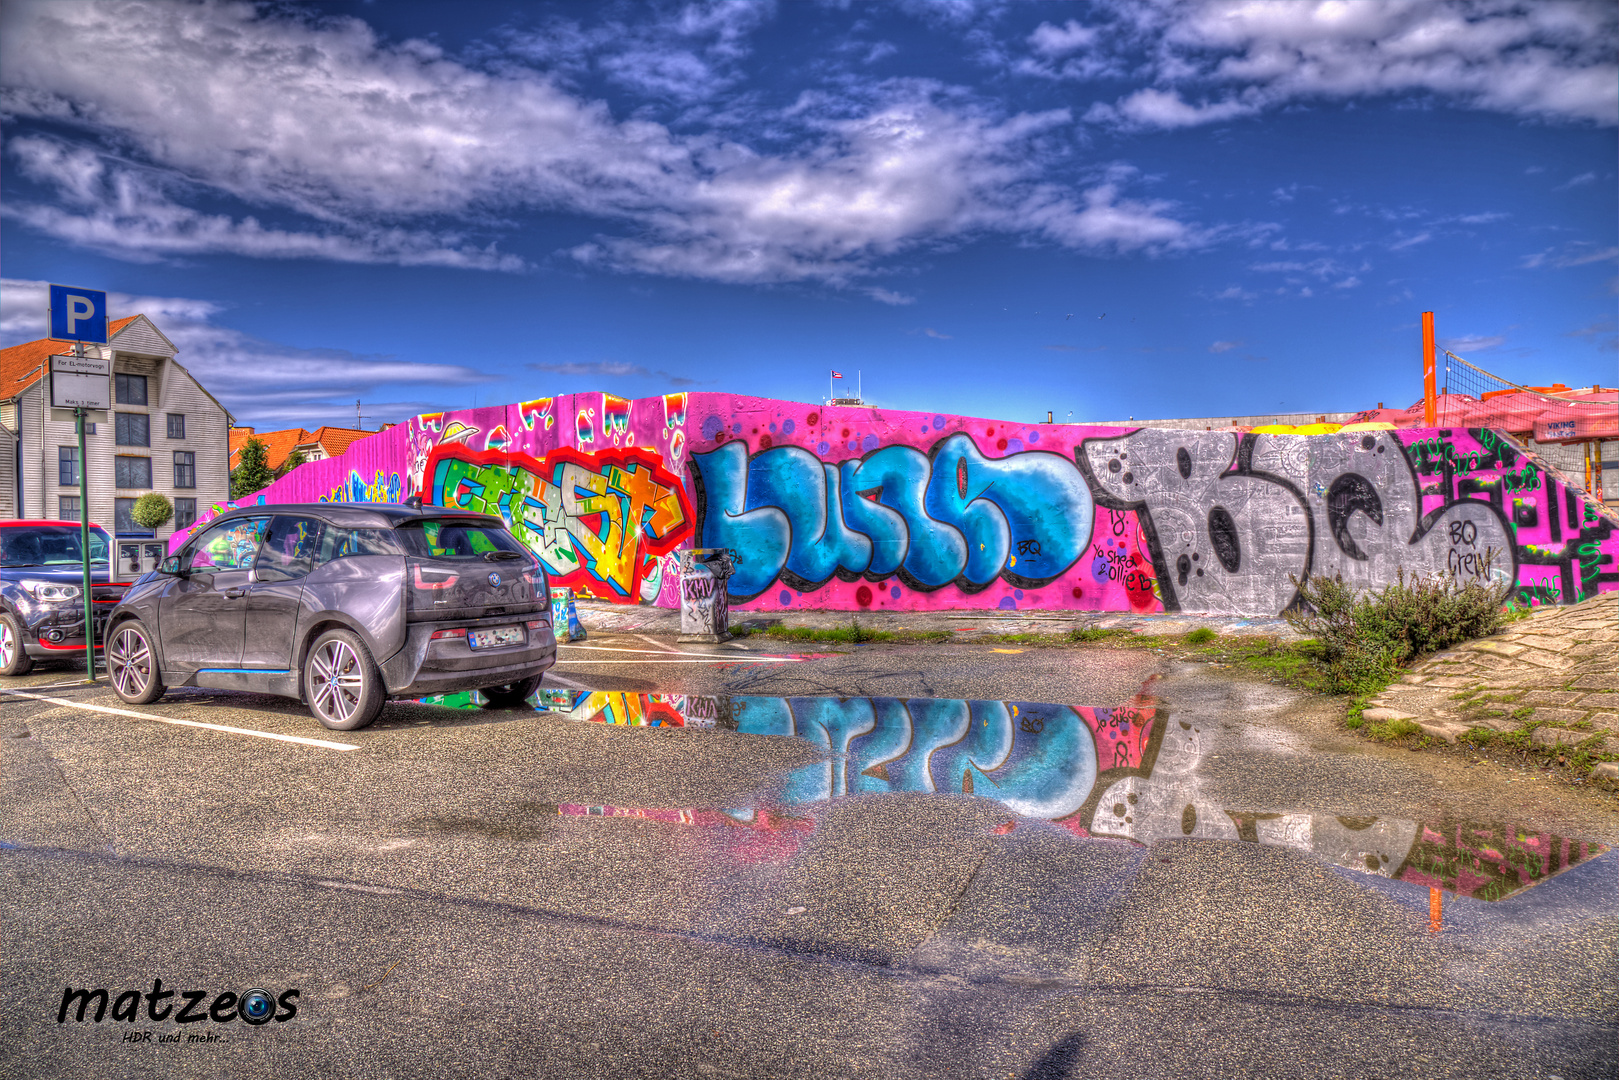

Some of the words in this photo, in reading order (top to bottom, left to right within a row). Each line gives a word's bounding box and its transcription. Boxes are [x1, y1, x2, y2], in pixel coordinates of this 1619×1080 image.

[66, 294, 95, 334] P
[1547, 420, 1576, 430] VIKING
[1449, 520, 1477, 550] BQ
[1016, 539, 1042, 557] BQ
[682, 578, 715, 600] KMV
